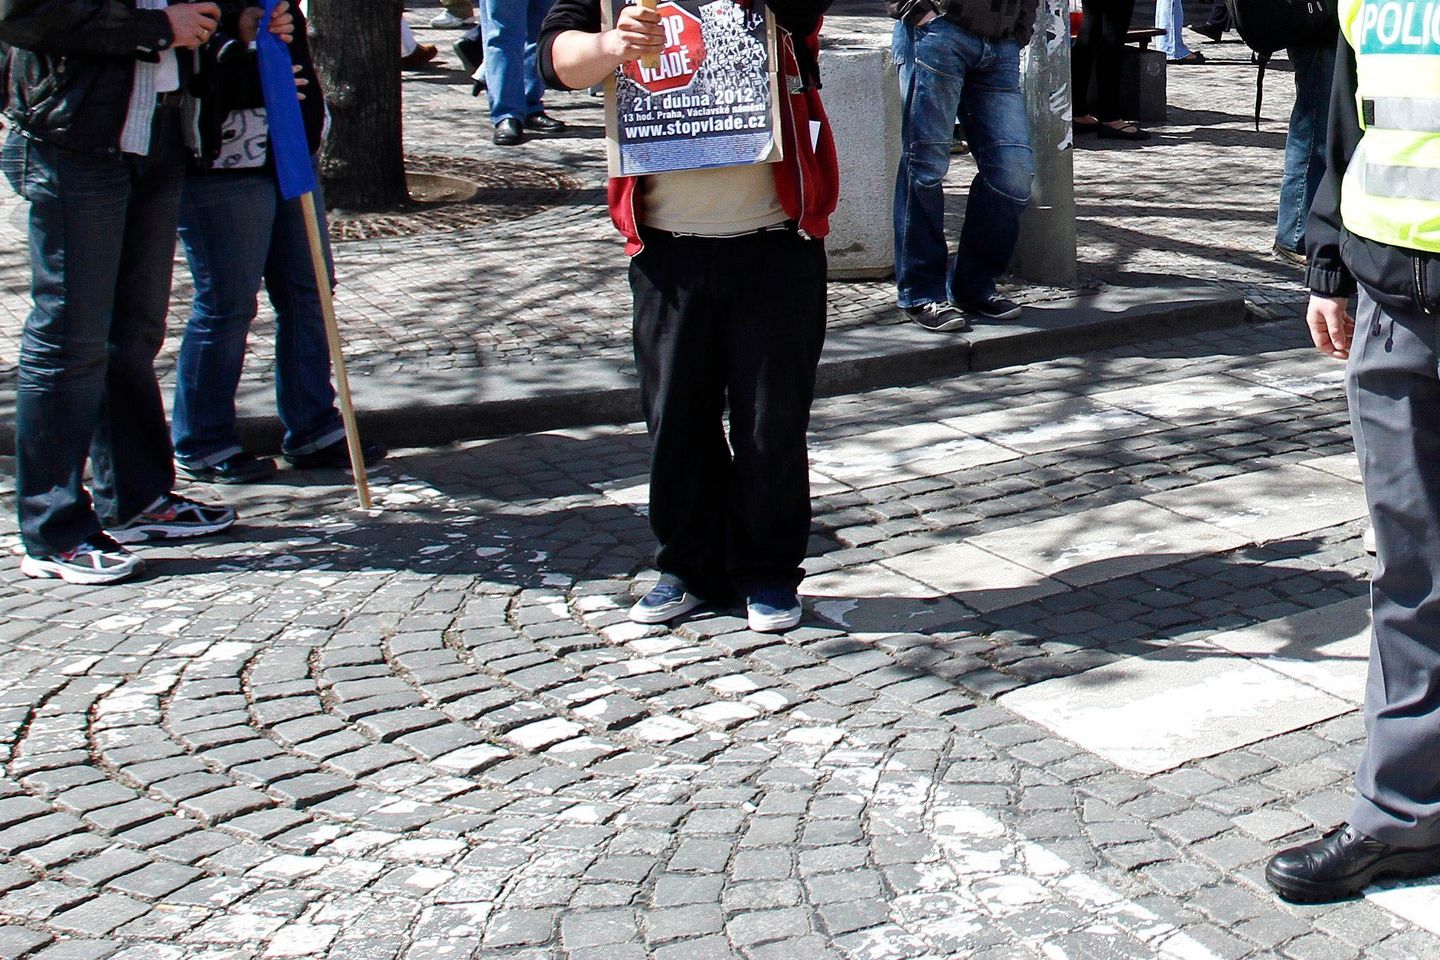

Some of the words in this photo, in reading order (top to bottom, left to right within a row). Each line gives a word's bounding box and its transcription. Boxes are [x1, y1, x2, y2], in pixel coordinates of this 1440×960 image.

[633, 96, 657, 112] 21.
[663, 93, 710, 110] dubna
[715, 88, 754, 105] 2012
[623, 113, 634, 122] 13
[657, 110, 685, 120] Praha,
[687, 105, 730, 117] Václavské
[625, 114, 766, 139] www.stopvlade.cz
